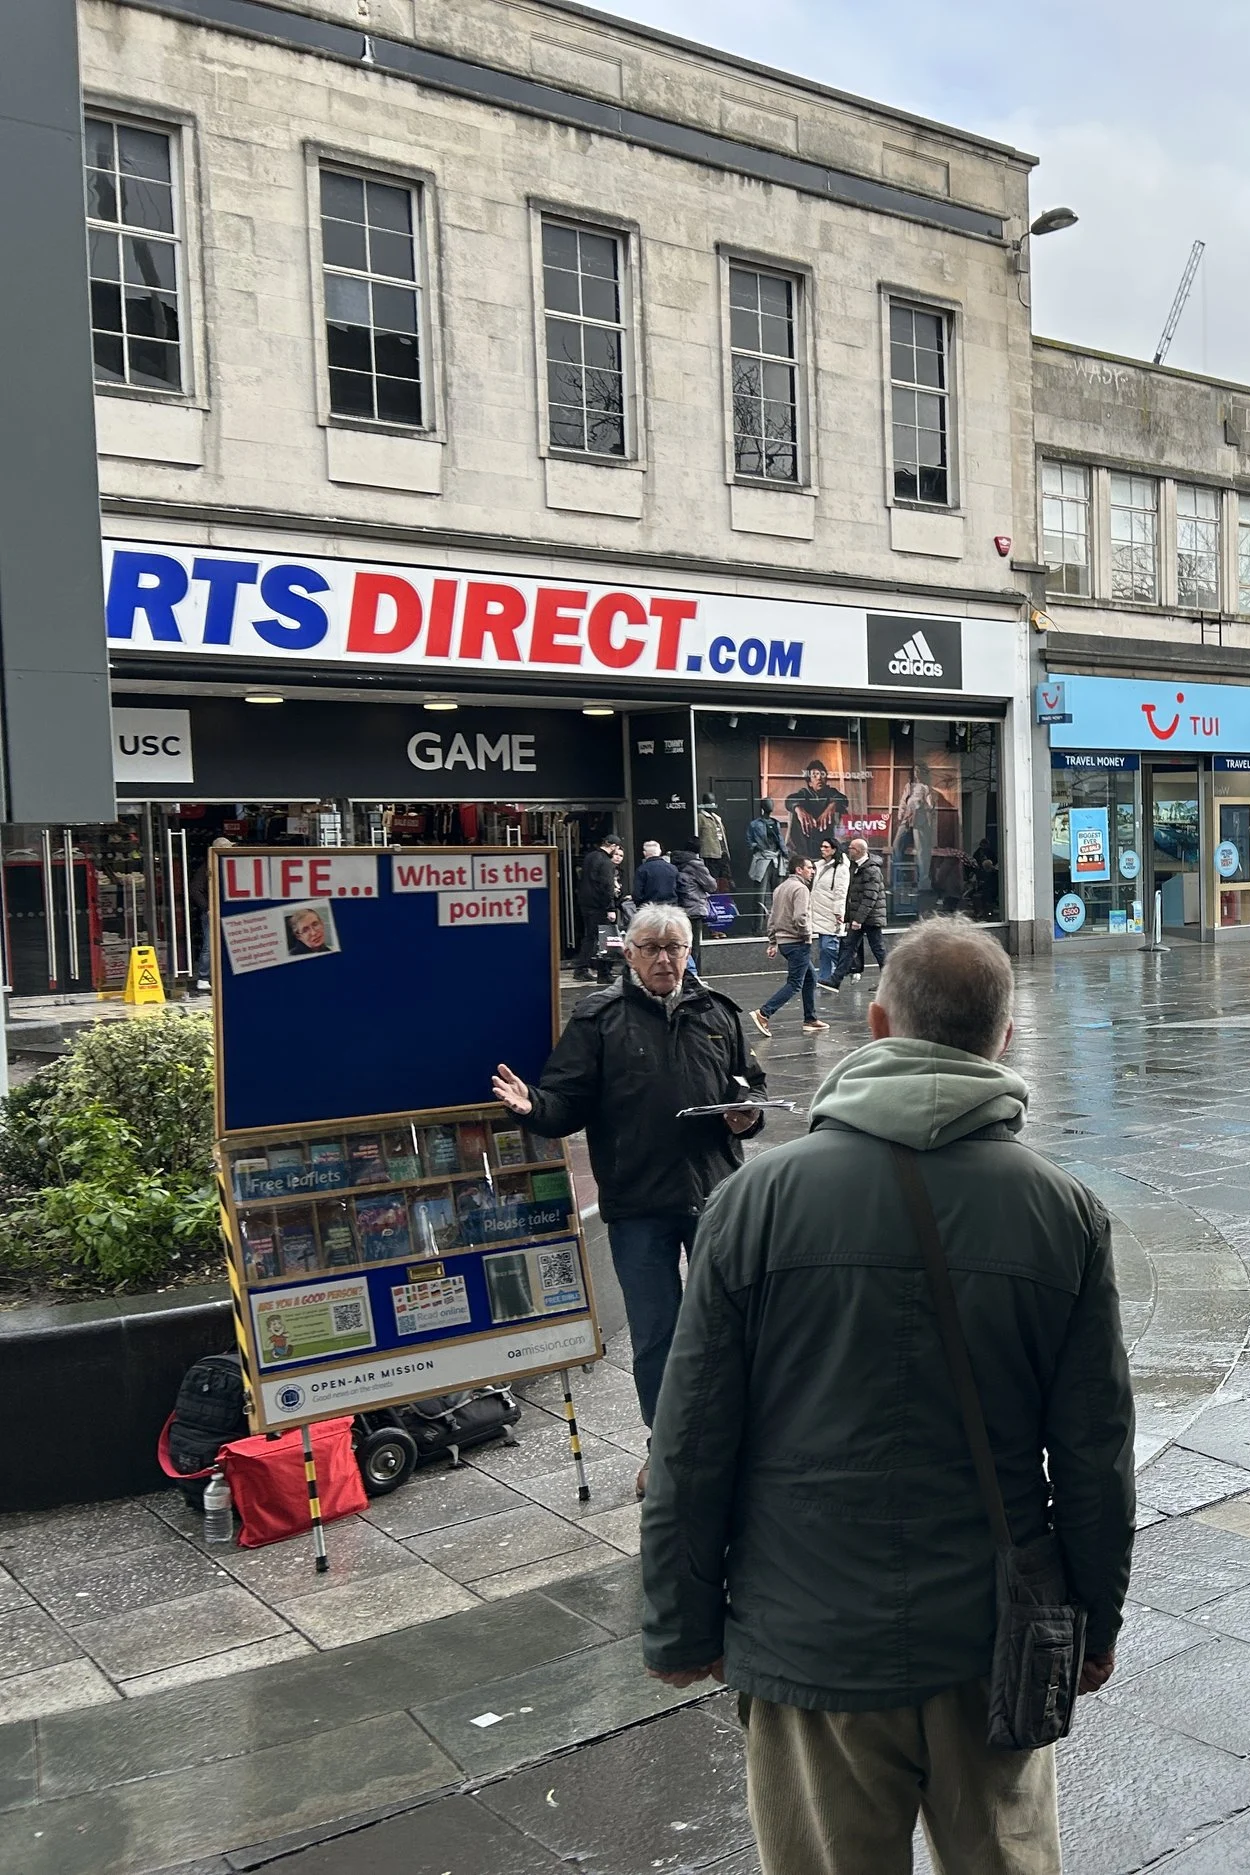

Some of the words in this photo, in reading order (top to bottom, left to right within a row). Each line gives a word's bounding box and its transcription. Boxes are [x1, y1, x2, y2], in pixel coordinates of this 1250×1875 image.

[888, 659, 943, 678] adidas
[1189, 716, 1219, 737] TUI
[119, 735, 181, 756] USC
[407, 731, 537, 772] GAME
[1065, 755, 1095, 766] TRAVEL
[1097, 756, 1125, 767] MONEY
[1226, 758, 1250, 769] TRAVEL
[397, 864, 466, 886] What
[480, 863, 498, 884] is
[503, 862, 543, 883] the
[450, 895, 526, 923] point?
[1062, 907, 1079, 916] £500
[251, 1177, 283, 1192] Free
[287, 1170, 341, 1188] leaflets
[484, 1217, 526, 1232] Please
[528, 1209, 560, 1225] take!
[258, 1301, 274, 1312] ARE
[275, 1298, 292, 1309] YOU
[293, 1297, 300, 1306] A
[301, 1292, 326, 1305] GOOD
[327, 1286, 364, 1300] PERSON?
[545, 1296, 561, 1304] FREE
[417, 1311, 438, 1321] Read
[440, 1305, 468, 1317] online!
[507, 1335, 586, 1359] oamission.com
[311, 1372, 375, 1392] OPEN-AIR
[381, 1360, 434, 1378] MISSION
[313, 1393, 332, 1403] Good
[332, 1391, 349, 1399] news
[360, 1385, 371, 1394] the
[371, 1381, 394, 1391] streets
